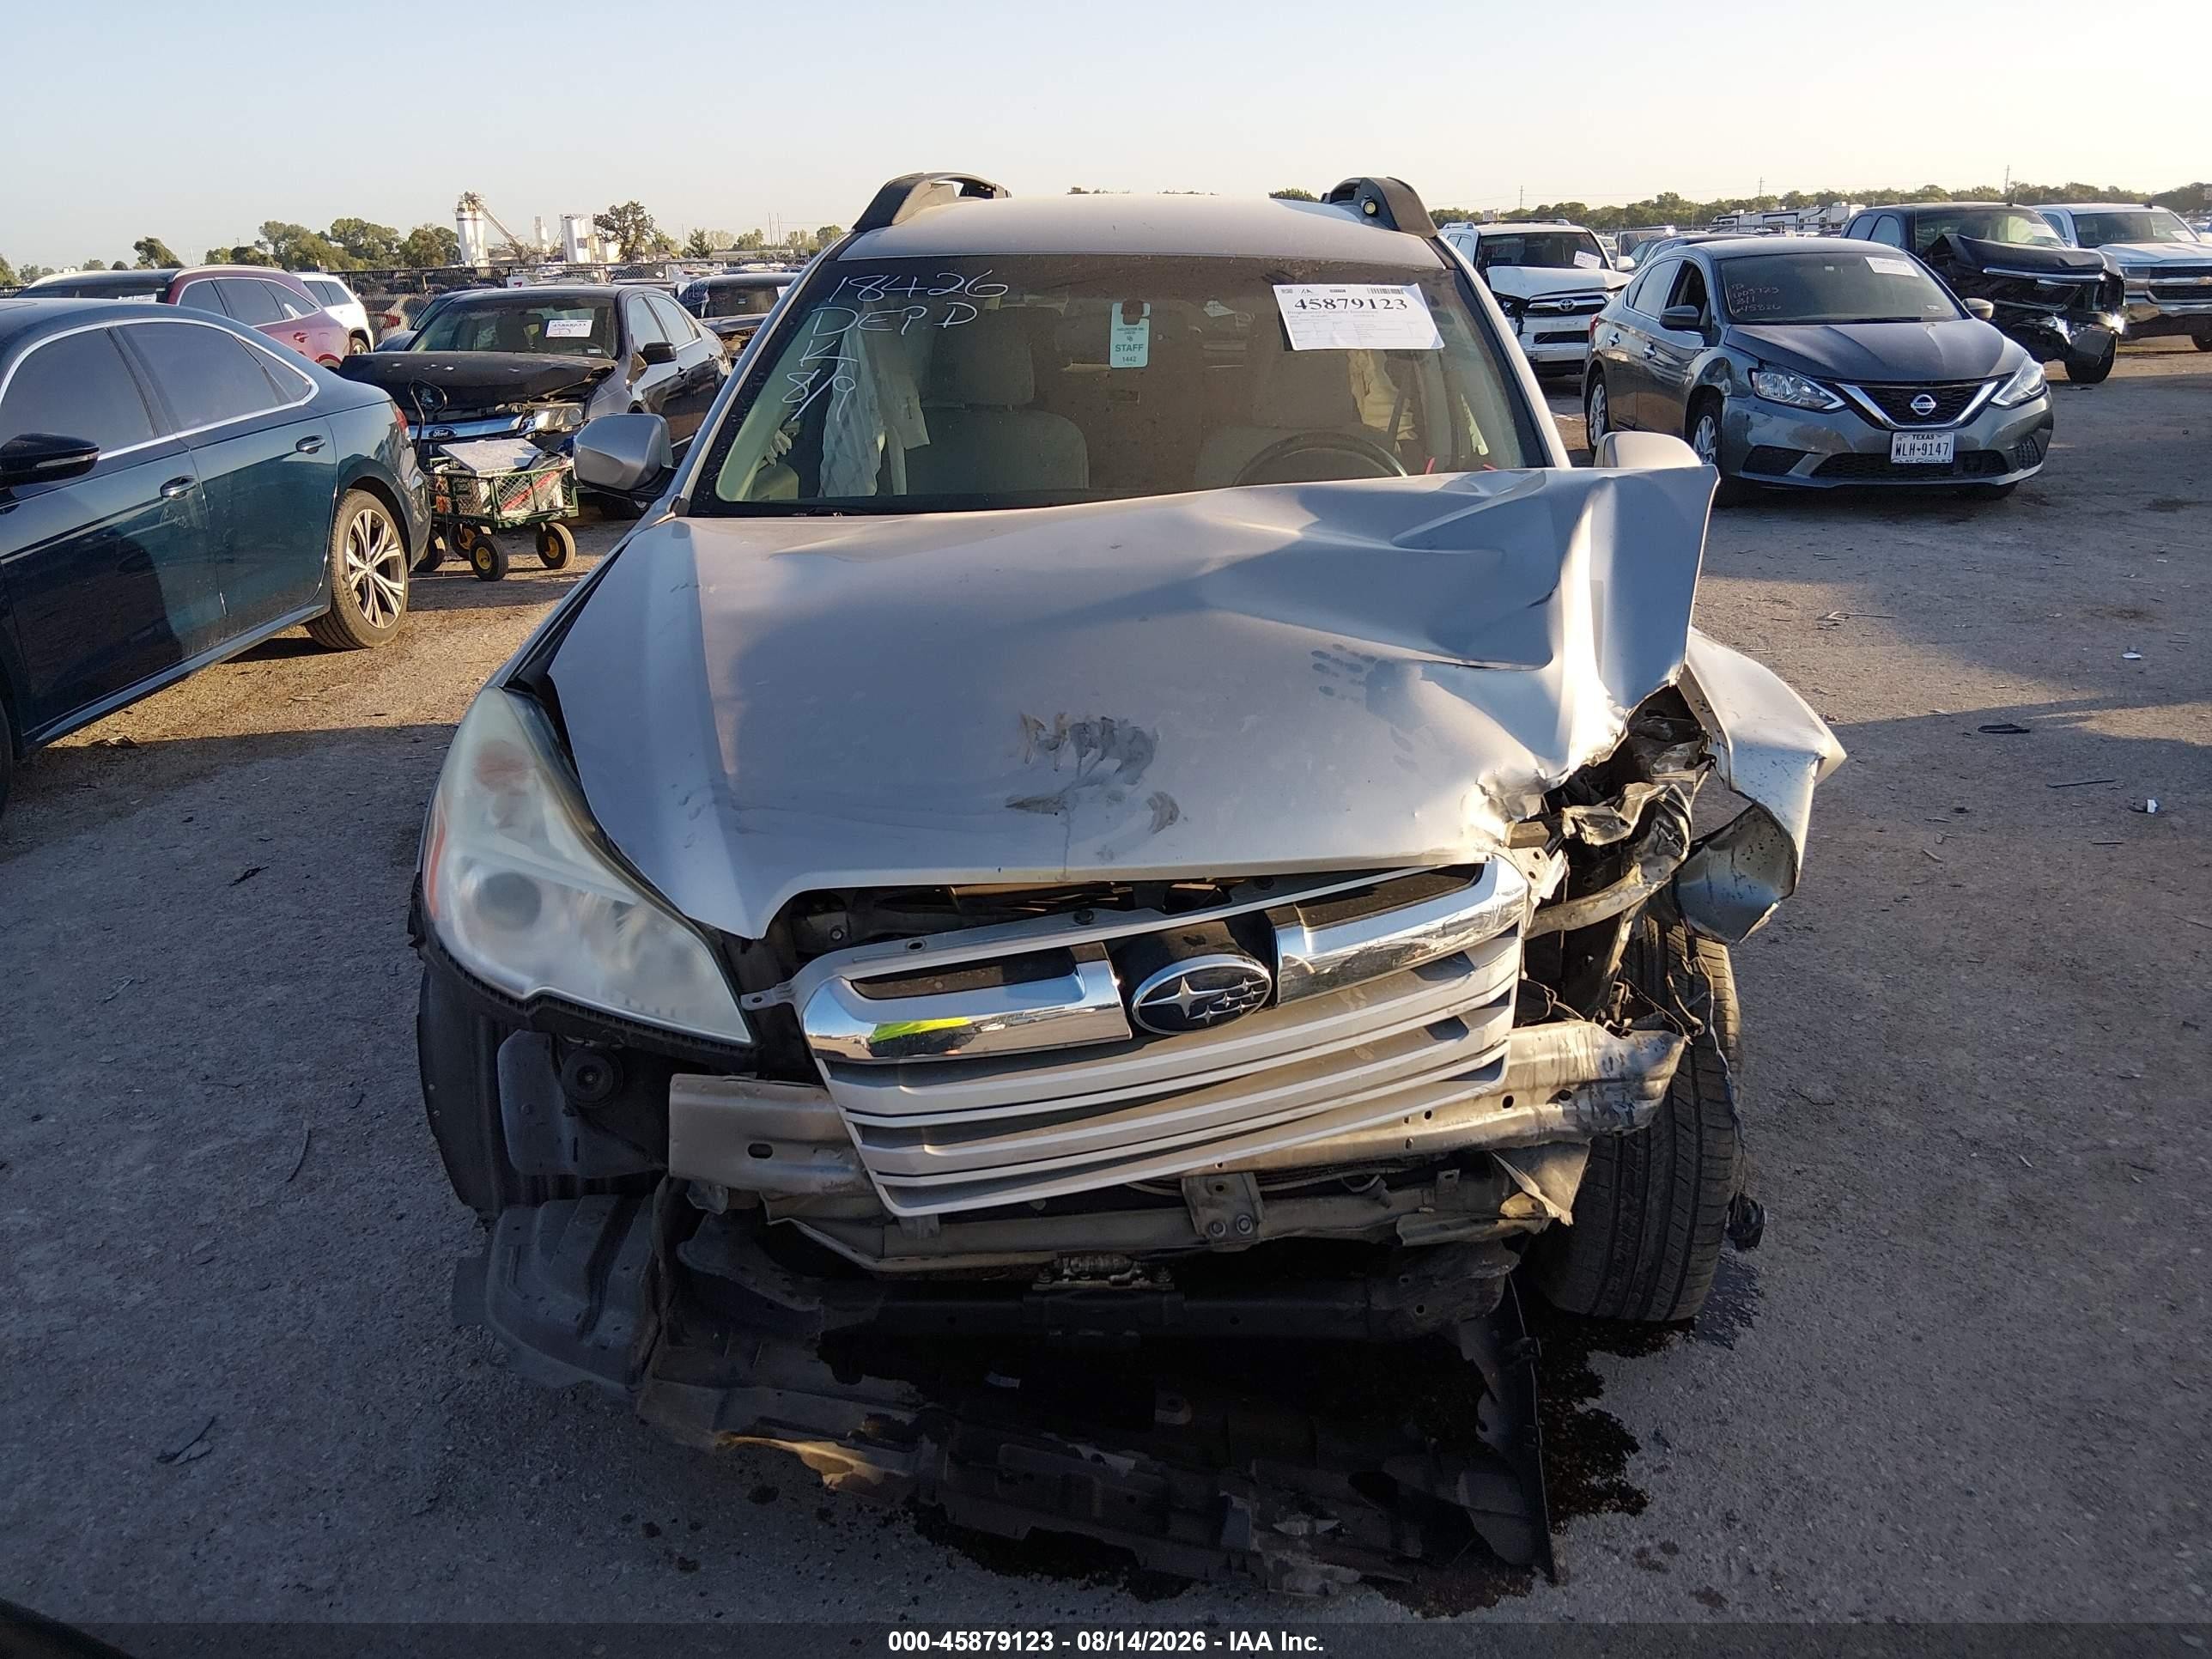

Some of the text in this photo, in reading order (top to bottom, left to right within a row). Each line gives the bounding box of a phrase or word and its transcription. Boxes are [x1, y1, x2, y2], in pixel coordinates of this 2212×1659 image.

[828, 270, 1008, 302] 18426
[1294, 298, 1408, 310] 45879123
[1115, 343, 1144, 352] STAFF
[781, 363, 856, 421] 8/9
